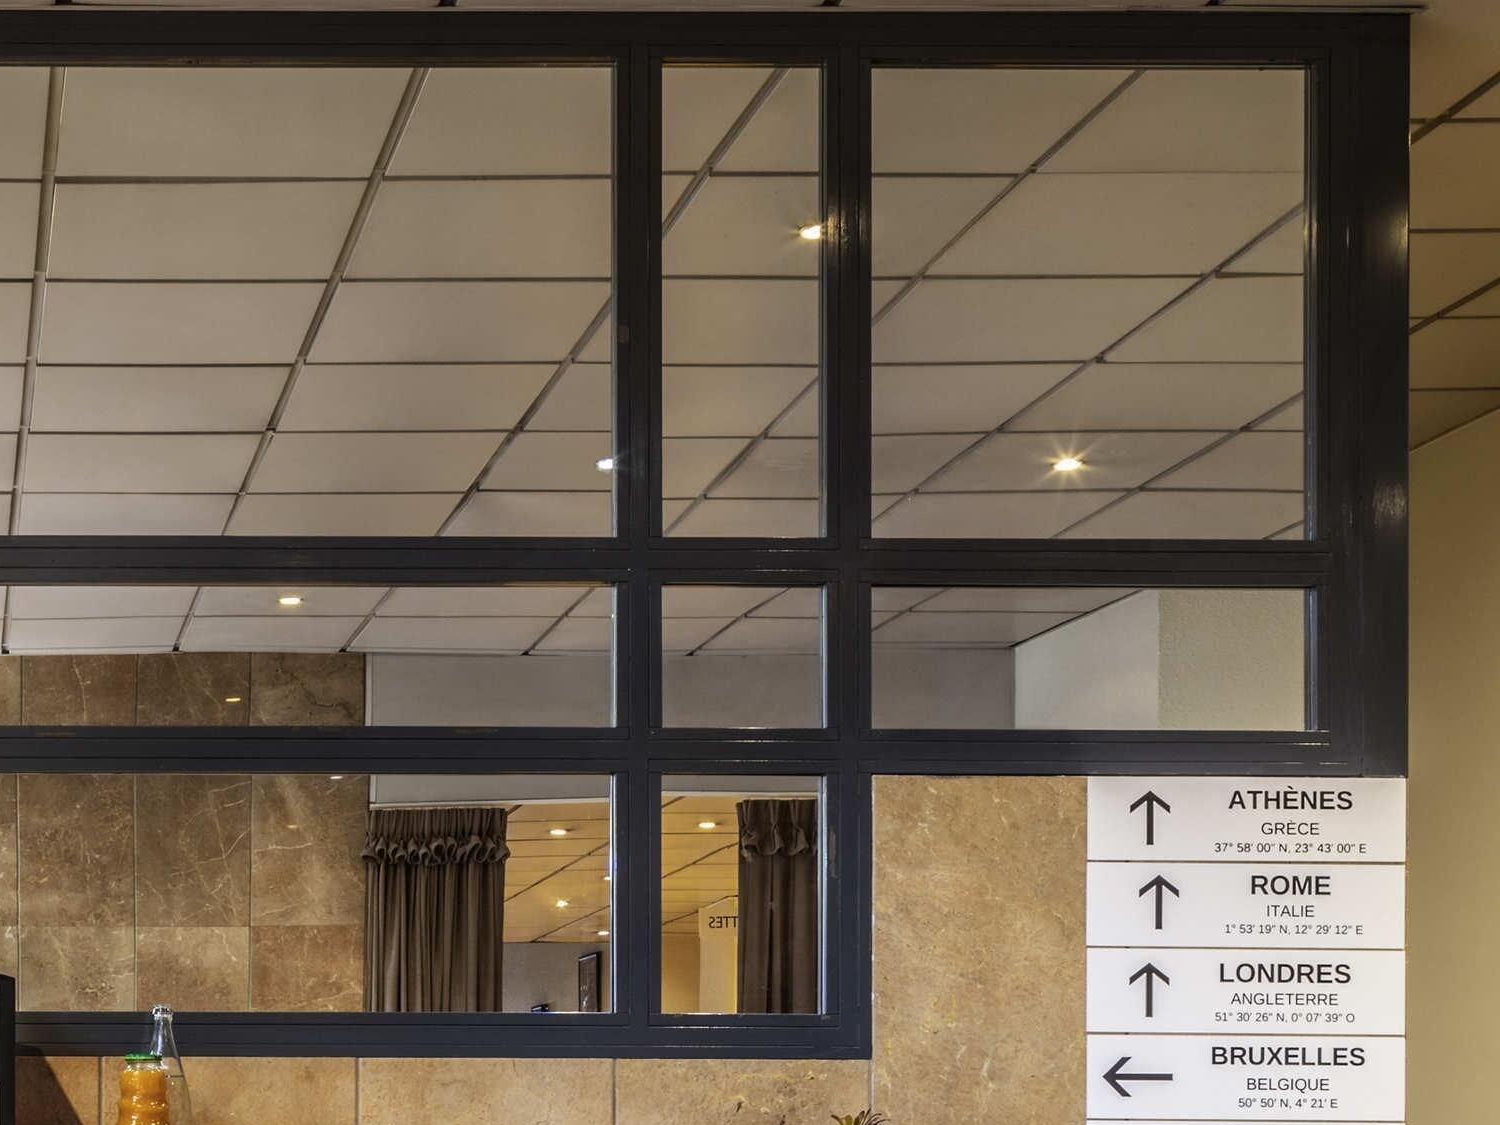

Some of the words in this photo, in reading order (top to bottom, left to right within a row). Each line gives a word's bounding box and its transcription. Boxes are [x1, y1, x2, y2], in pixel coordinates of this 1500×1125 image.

[1227, 785, 1354, 811] ATHÈNES
[1260, 819, 1321, 836] GRÈCE
[1358, 843, 1367, 854] E
[1250, 874, 1332, 897] ROME
[1266, 904, 1316, 918] ITALIE
[1355, 924, 1364, 936] E
[1219, 962, 1352, 985] LONDRES
[1230, 992, 1340, 1007] ANGLETERRE
[1345, 1012, 1356, 1024] O
[1211, 1046, 1366, 1067] BRUXELLES
[1246, 1077, 1331, 1095] BELGIQUE
[1329, 1098, 1339, 1109] E
